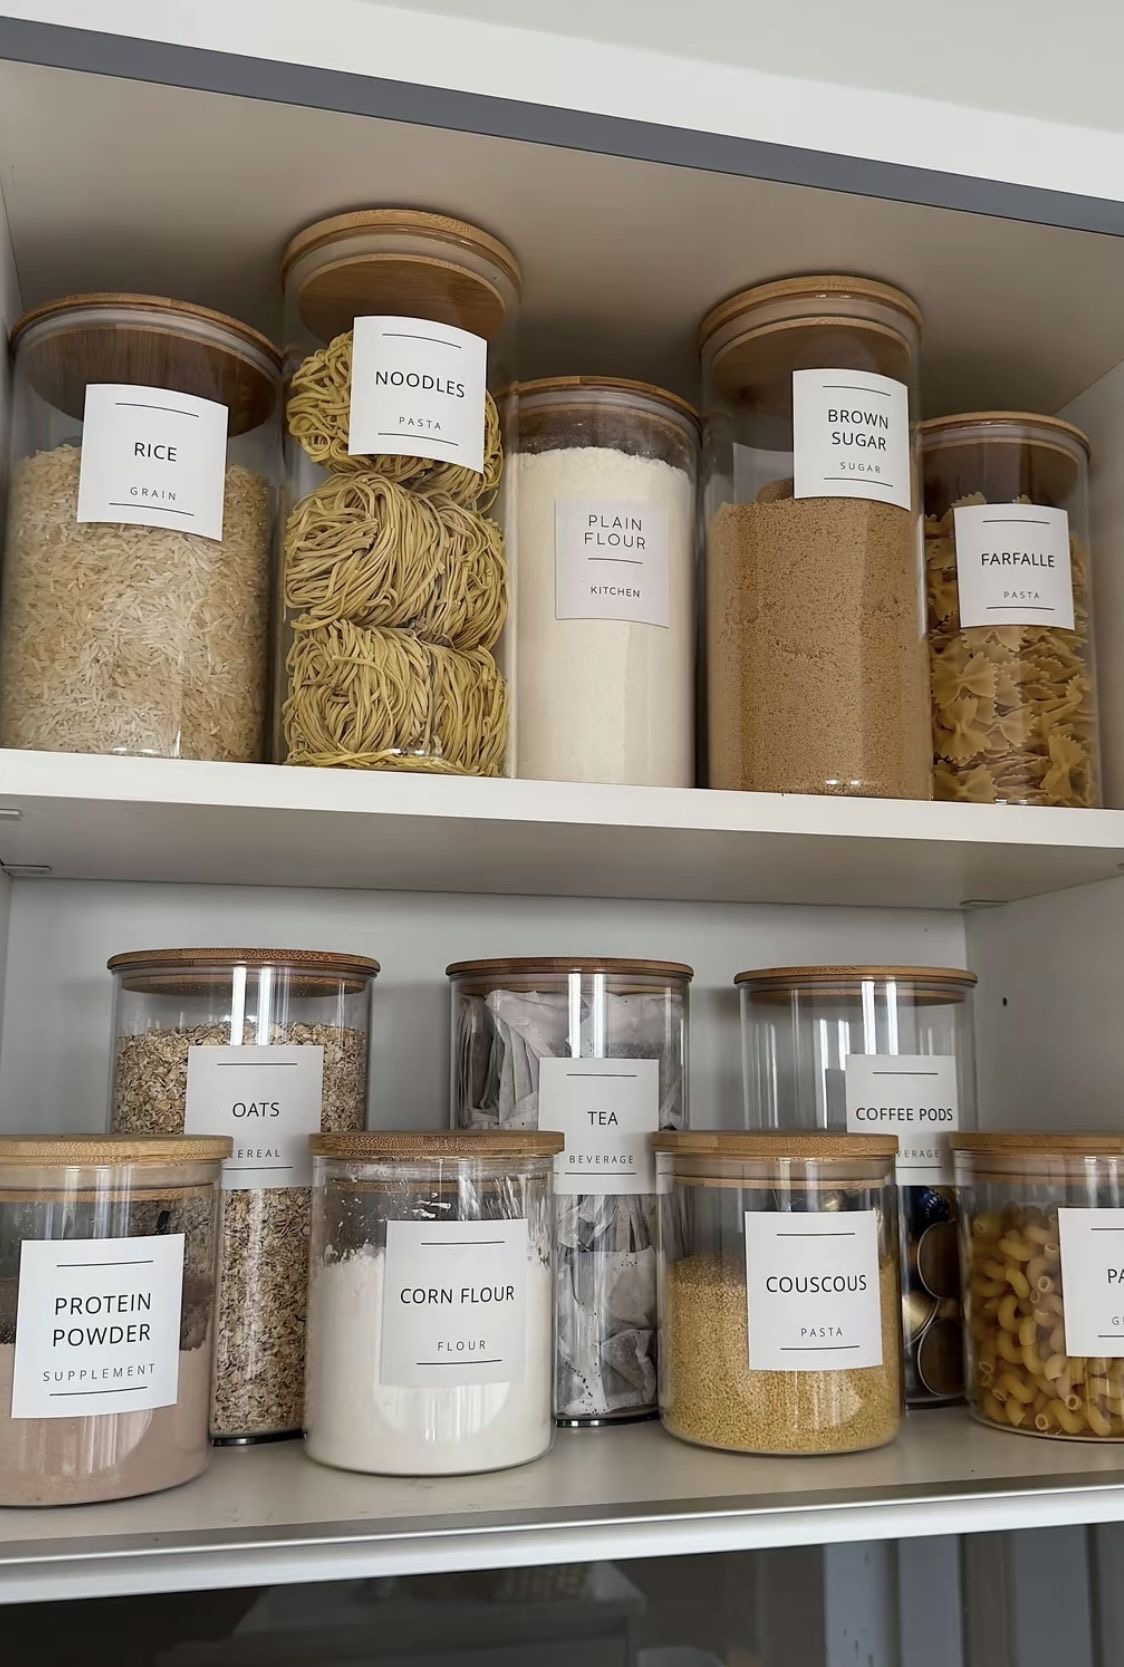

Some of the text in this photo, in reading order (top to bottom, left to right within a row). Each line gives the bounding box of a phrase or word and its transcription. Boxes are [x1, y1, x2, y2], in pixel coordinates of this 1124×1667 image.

[375, 370, 465, 398] NOODLES
[398, 416, 441, 431] PASTA
[827, 408, 889, 430] BROWN
[831, 431, 887, 452] SUGAR
[134, 441, 177, 463] RICE
[839, 460, 882, 474] SUGAR
[129, 486, 176, 501] GRAIN
[588, 514, 642, 532] PLAIN
[584, 528, 646, 550] FLOUR
[981, 552, 1055, 569] FARFALLE
[590, 586, 641, 598] KITCHEN
[1003, 590, 1040, 600] PASTA
[232, 1101, 280, 1118] OATS
[587, 1110, 619, 1126] TEA
[855, 1107, 953, 1122] COFFEE PODS
[230, 1148, 281, 1159] EREAL
[568, 1154, 634, 1165] BEVERAGE
[765, 1274, 867, 1294] COUSCOUS
[1107, 1268, 1124, 1284] PA
[400, 1285, 515, 1305] CORN FLOUR
[54, 1292, 151, 1316] PROTEIN
[52, 1323, 151, 1348] POWDER
[800, 1327, 843, 1338] PASTA
[437, 1339, 486, 1352] FLOUR
[42, 1362, 155, 1382] SUPPLEMENT
